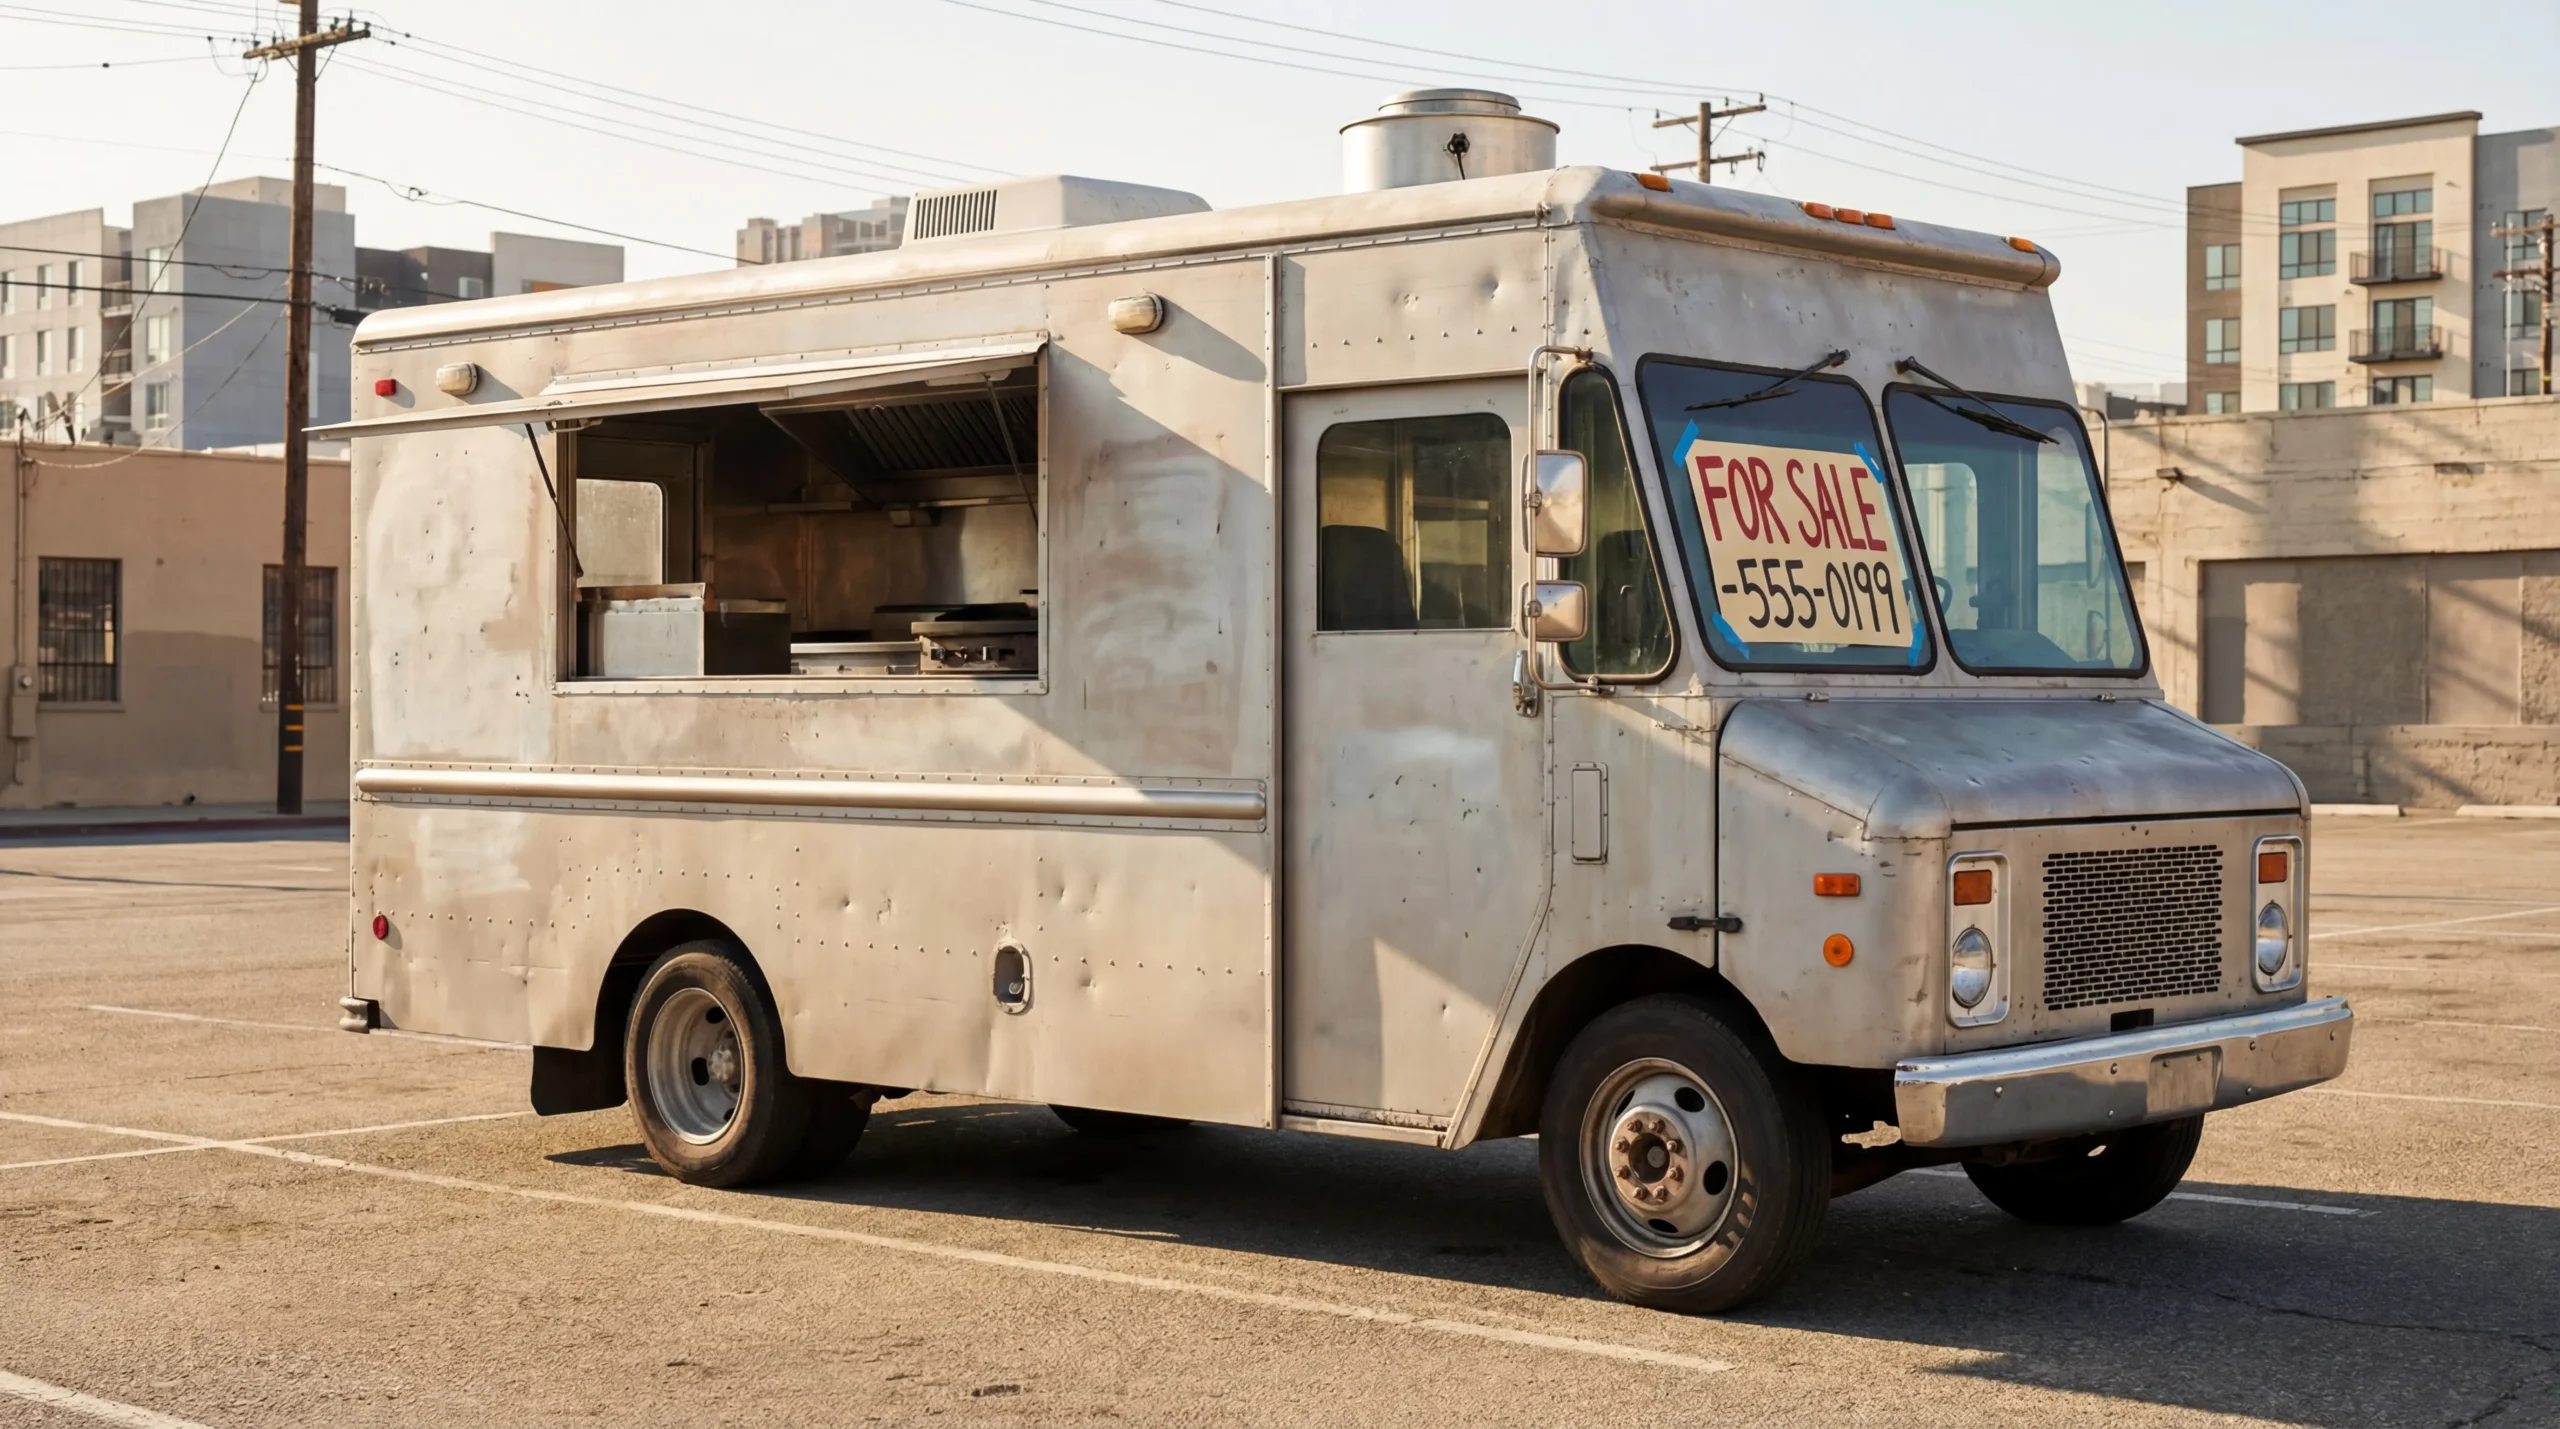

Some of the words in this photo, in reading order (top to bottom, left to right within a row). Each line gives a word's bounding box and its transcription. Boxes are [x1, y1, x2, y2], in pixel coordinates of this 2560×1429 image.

[1695, 456, 1790, 544] FOR
[1786, 458, 1888, 552] SALE
[1721, 558, 1900, 635] -555-0199
